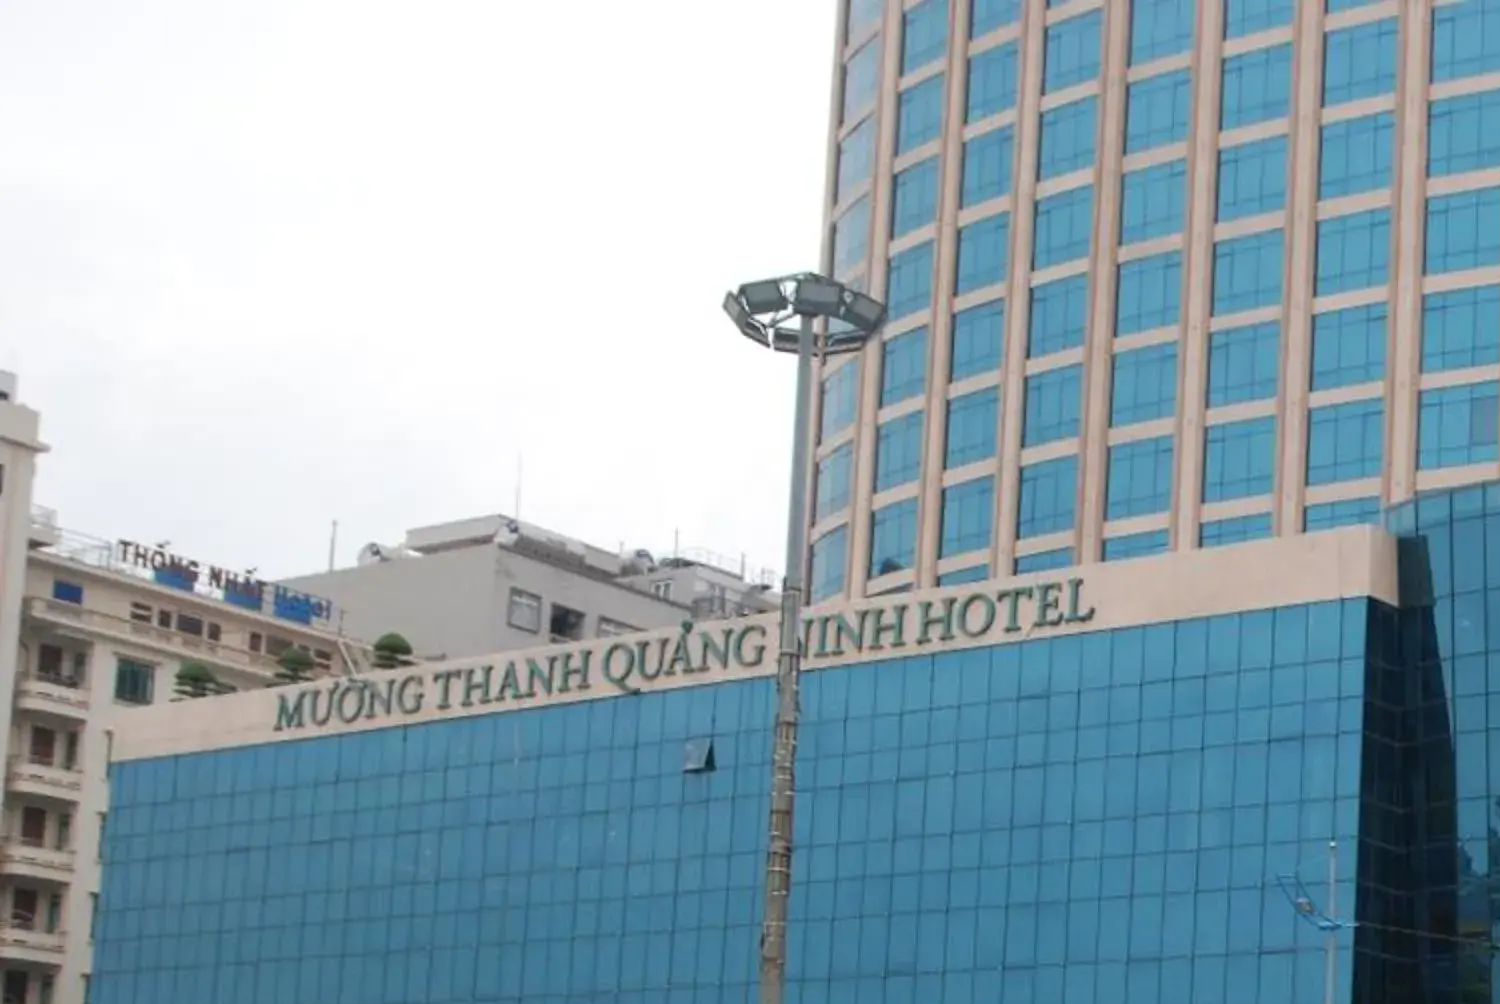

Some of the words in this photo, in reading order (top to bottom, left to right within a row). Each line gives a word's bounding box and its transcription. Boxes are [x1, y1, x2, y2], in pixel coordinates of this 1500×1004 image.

[118, 538, 199, 582] THỐNG
[274, 676, 424, 731] MƯỜNG
[433, 649, 593, 710] THANH
[602, 620, 767, 692] QUẢNG
[917, 577, 1096, 644] HOTEL
